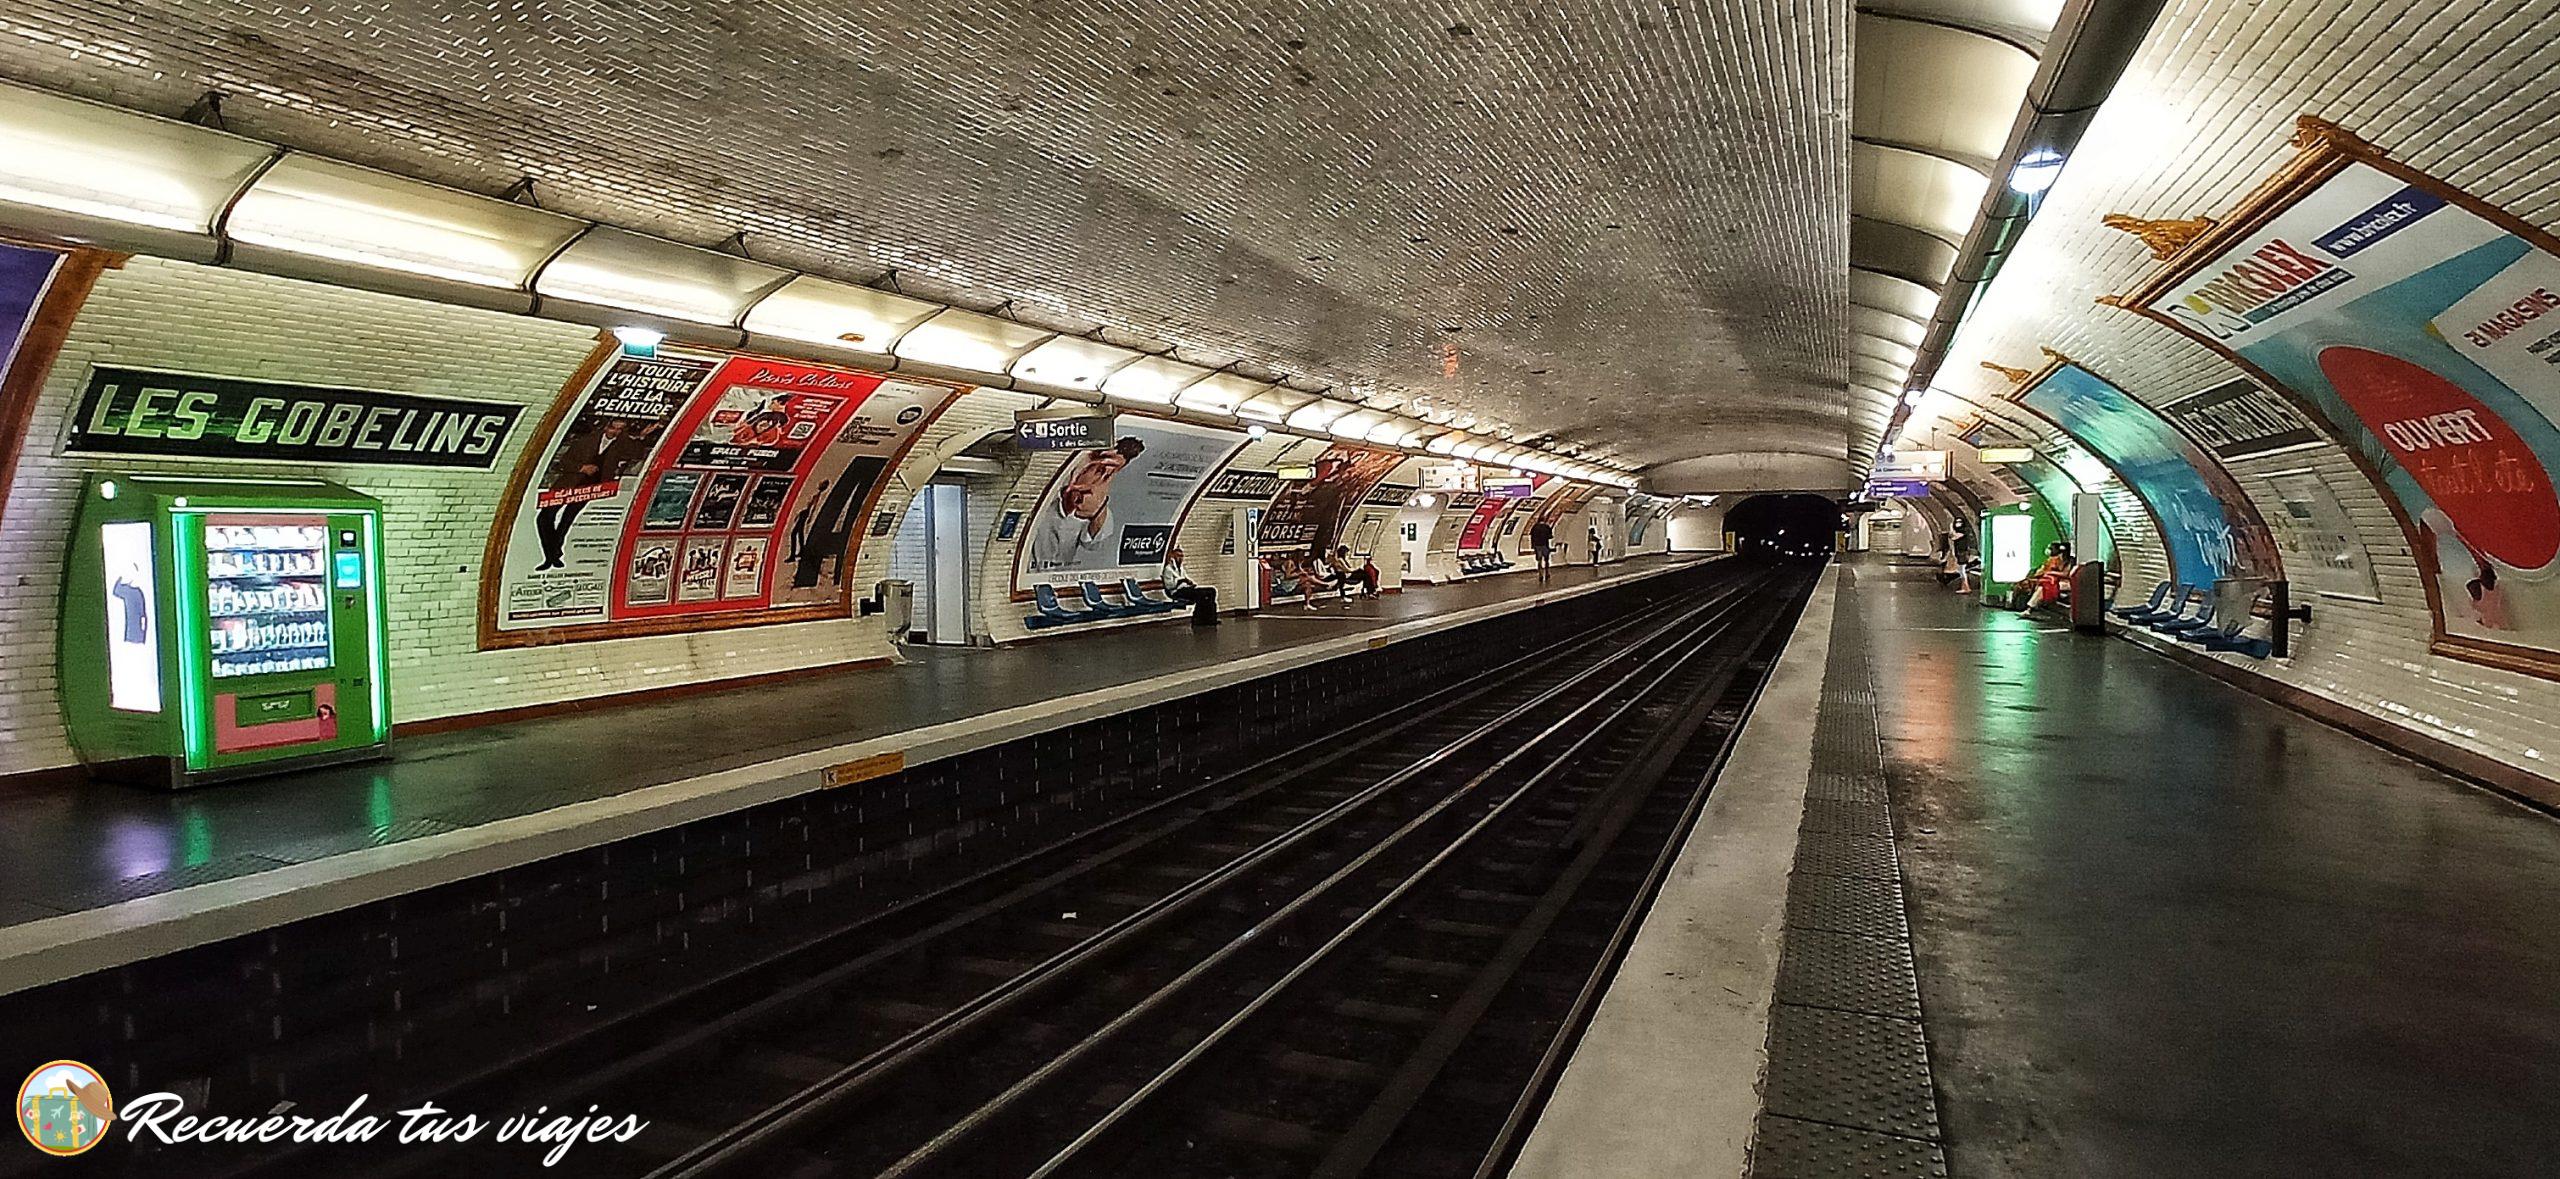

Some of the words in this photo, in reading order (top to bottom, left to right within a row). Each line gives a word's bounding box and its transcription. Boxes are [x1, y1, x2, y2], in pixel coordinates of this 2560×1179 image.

[2328, 200, 2419, 253] www.bricolex.fr
[2193, 238, 2335, 314] BRICOLEX
[2477, 287, 2560, 341] MAGASINS
[637, 364, 688, 380] TOUTE
[607, 373, 698, 393] L'HISTOIRE
[619, 388, 644, 401] DE
[644, 390, 664, 403] LA
[594, 399, 673, 416] PEINTURE
[2201, 389, 2304, 442] GOBELINS
[87, 384, 218, 440] LES
[235, 397, 504, 454] GOBELINS
[2179, 410, 2231, 448] LES
[1049, 422, 1088, 437] Sortie
[2383, 409, 2493, 452] OUVERT
[1211, 474, 1233, 493] LES
[1261, 525, 1303, 539] HORSE
[1123, 537, 1151, 550] PIGIER
